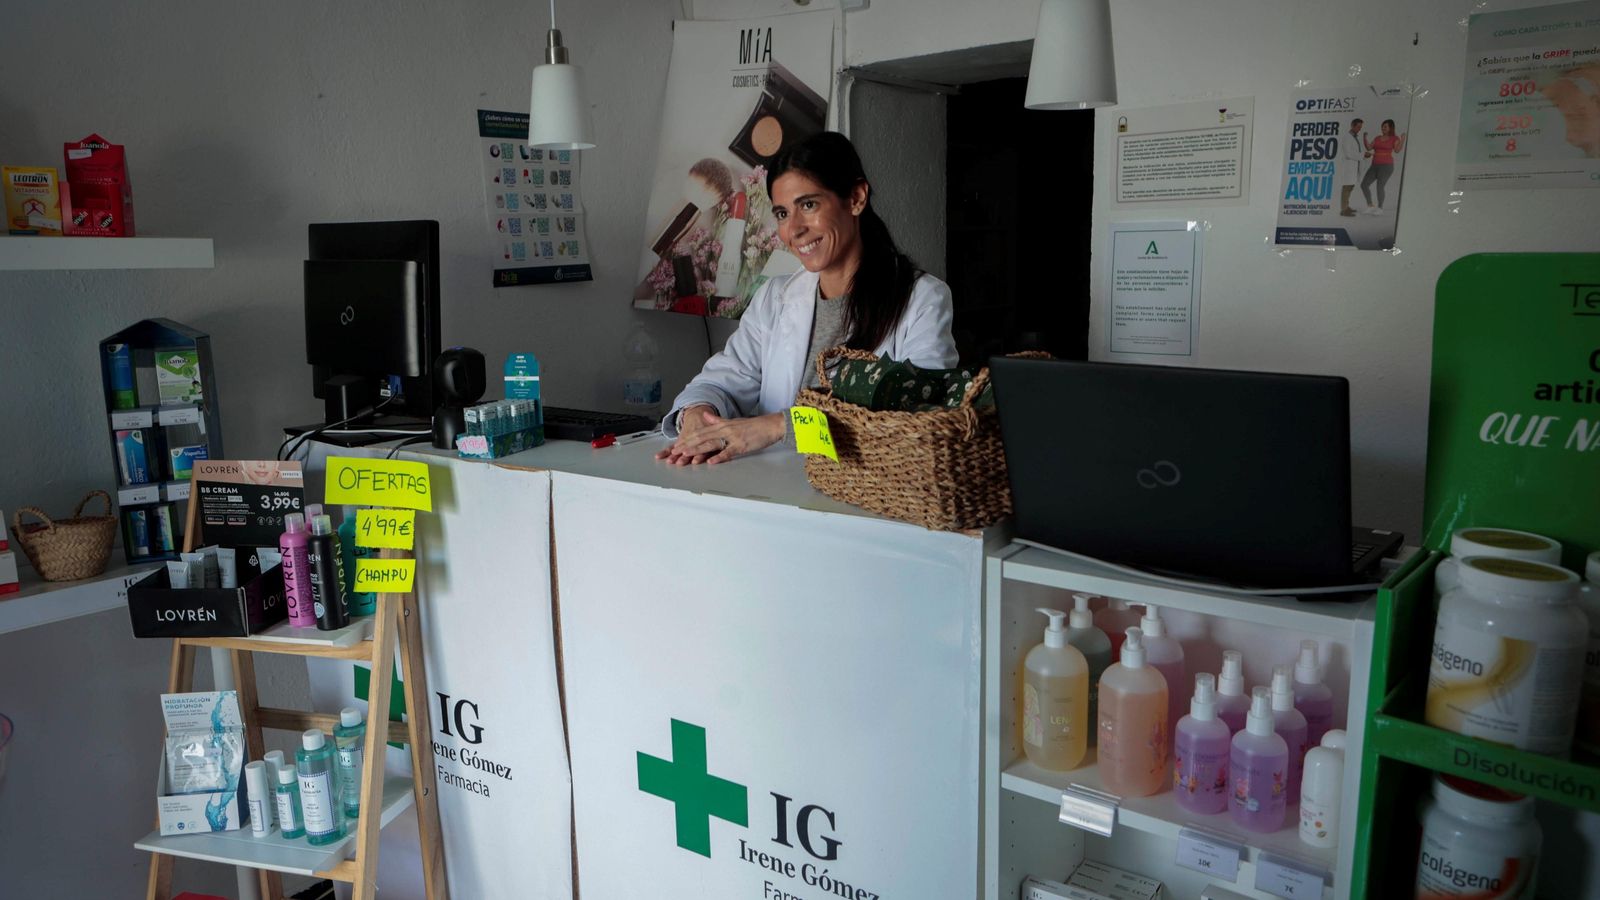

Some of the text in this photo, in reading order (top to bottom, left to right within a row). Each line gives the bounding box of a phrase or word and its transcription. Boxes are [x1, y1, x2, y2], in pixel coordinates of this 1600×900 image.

[1532, 52, 1540, 60] la
[1543, 49, 1571, 60] GRIPE
[1499, 80, 1536, 97] 800
[1296, 97, 1358, 111] OPTIFAST
[1293, 122, 1340, 136] PERDER
[1290, 138, 1338, 160] PESO
[1506, 138, 1517, 152] 8
[1288, 162, 1336, 175] EMPIEZA
[14, 174, 48, 183] LEOTRON
[1285, 174, 1333, 203] AQUÍ
[1480, 412, 1560, 447] QUE
[338, 466, 427, 495] OFERTAS
[260, 495, 300, 511] 3,99€
[356, 568, 408, 584] CHAMPU
[156, 607, 217, 622] LOVRÉN
[436, 691, 484, 744] IG
[430, 740, 513, 780] ene Gómez
[438, 765, 490, 798] Farmacia
[1454, 747, 1596, 801] Disolución
[770, 792, 842, 860] IG
[739, 838, 796, 878] Irene
[1199, 859, 1211, 868] 10€
[1422, 850, 1501, 891] colágeno
[1285, 885, 1294, 894] 7€
